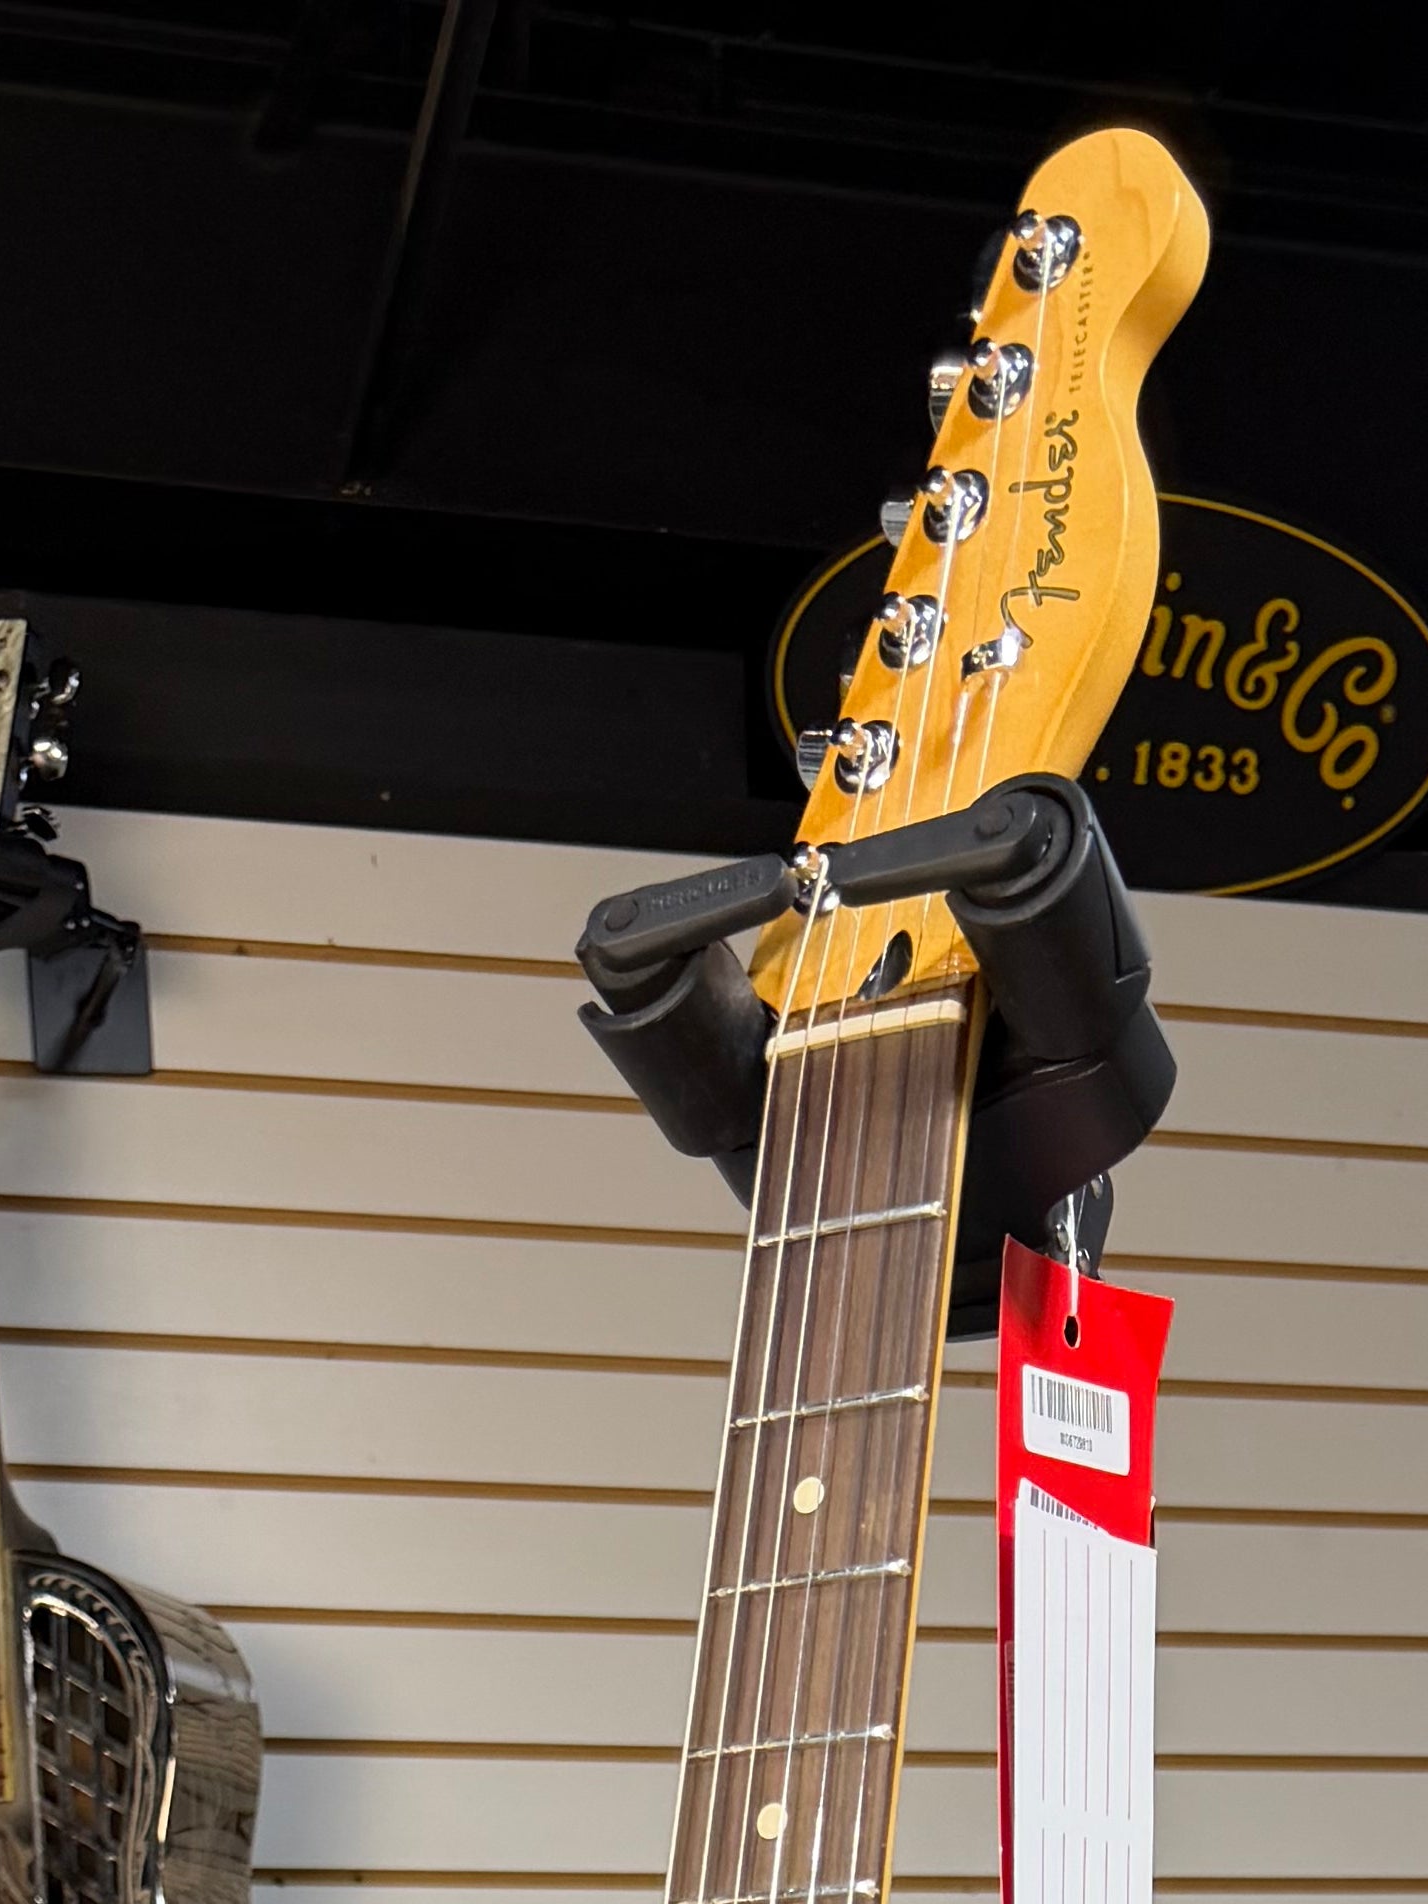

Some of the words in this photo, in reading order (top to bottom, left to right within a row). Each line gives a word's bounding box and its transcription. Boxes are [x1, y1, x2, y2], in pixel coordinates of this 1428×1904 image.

[1068, 263, 1094, 394] TELECASTER
[1000, 408, 1080, 650] Fender
[1132, 740, 1260, 795] 1833
